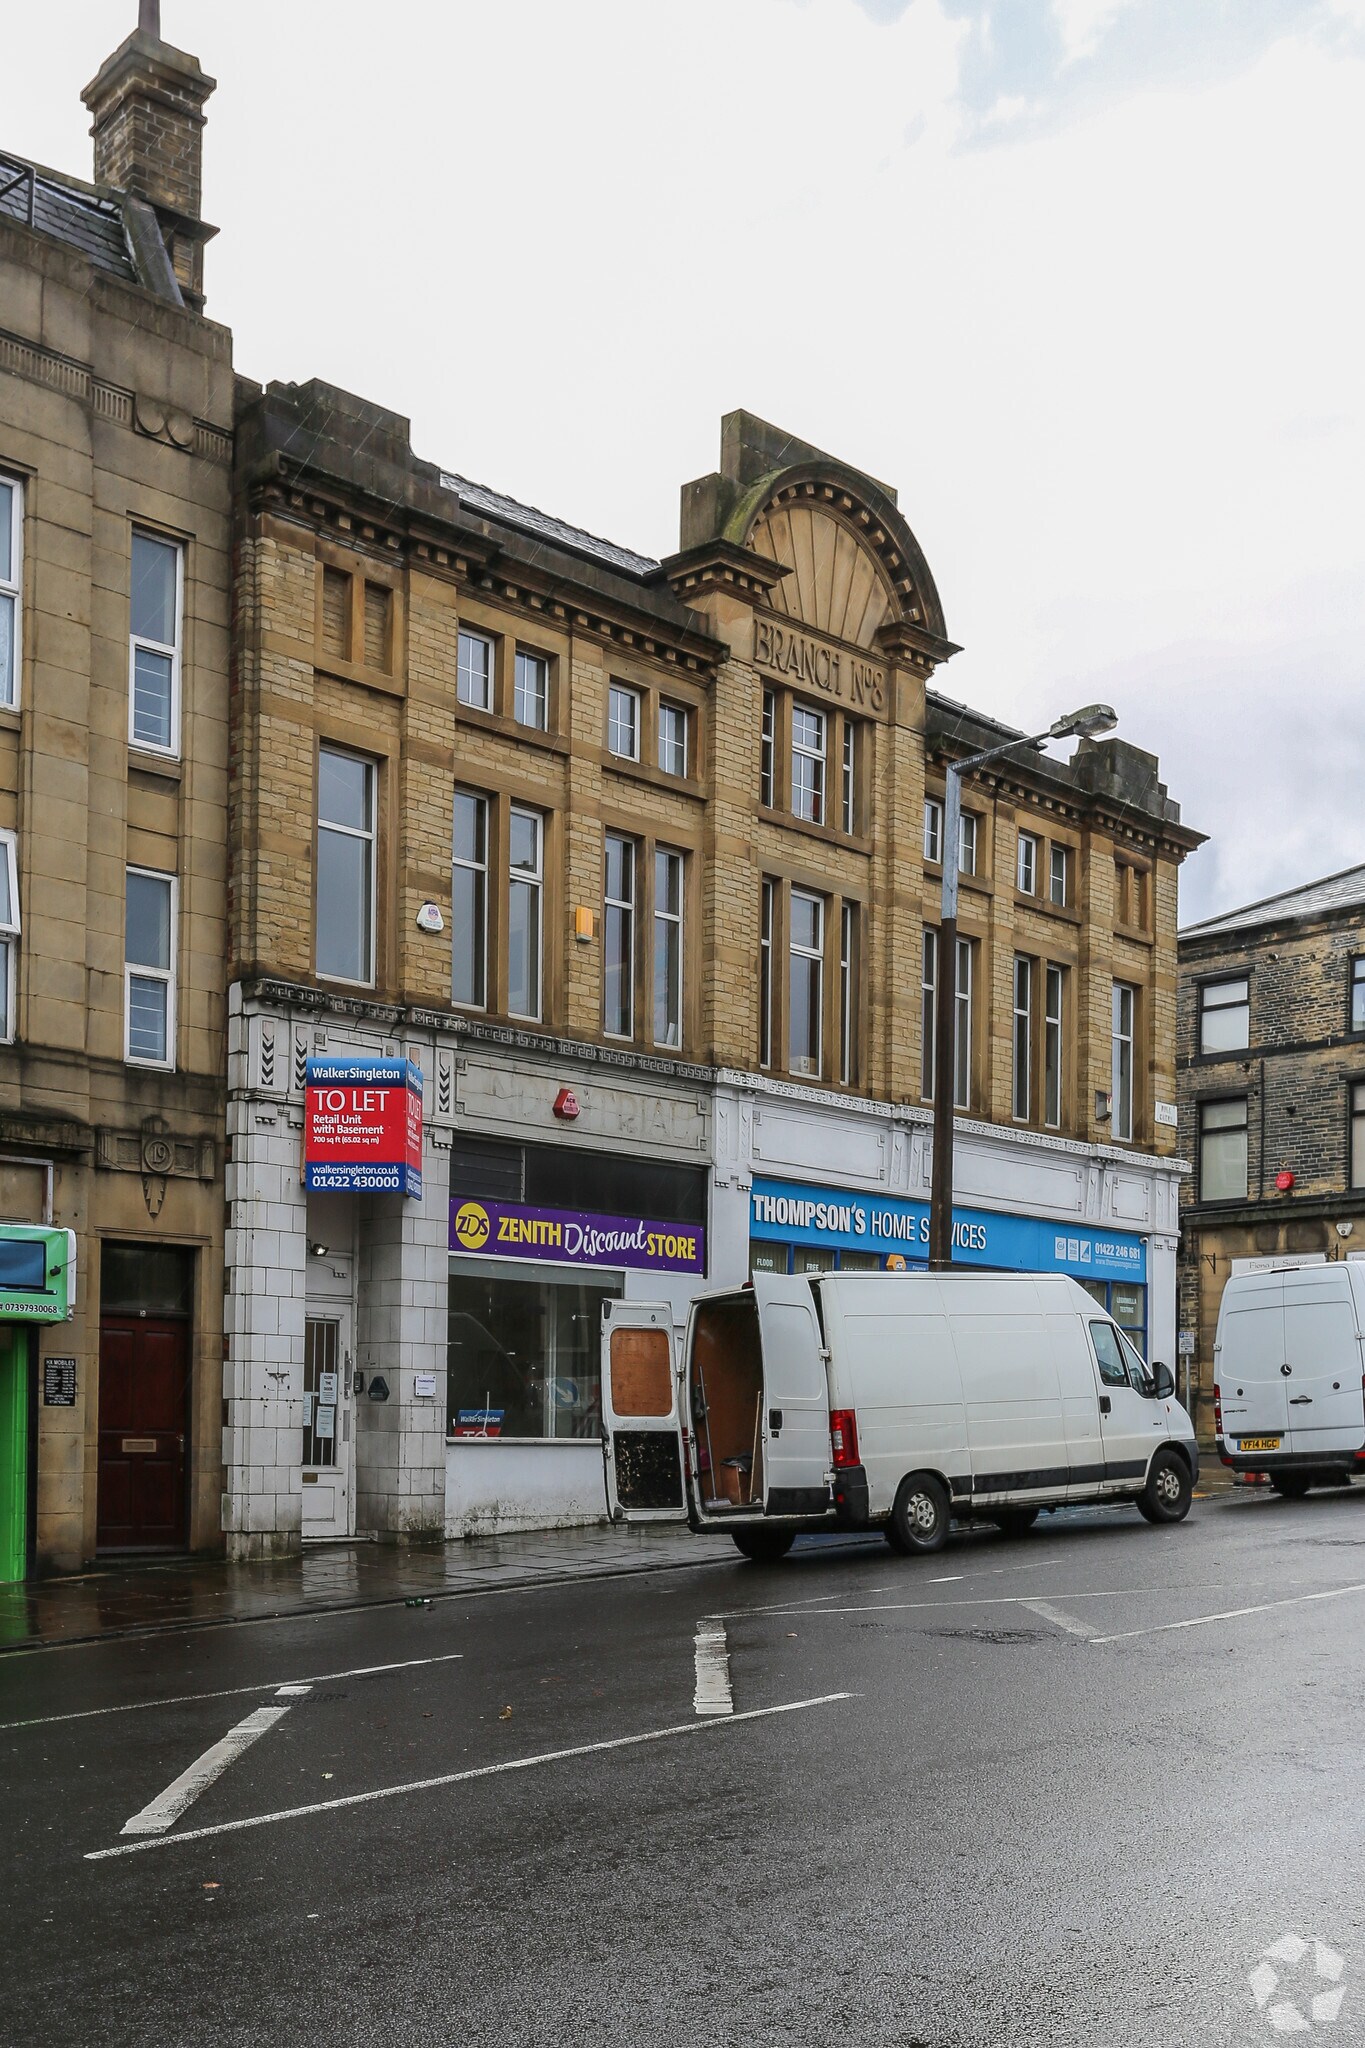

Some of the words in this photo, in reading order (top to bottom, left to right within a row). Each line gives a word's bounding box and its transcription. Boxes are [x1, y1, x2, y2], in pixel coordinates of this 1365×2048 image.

[754, 618, 842, 696] BRANCH
[313, 1090, 345, 1112] TO
[352, 1090, 390, 1112] LET
[313, 1114, 339, 1124] Retail
[341, 1115, 362, 1124] Unit
[313, 1124, 335, 1134] with
[337, 1125, 384, 1134] Basement
[326, 1137, 334, 1145] sq
[362, 1137, 370, 1145] sq
[370, 1136, 380, 1145] m)
[312, 1165, 399, 1176] walkersingleton.co.uk
[312, 1176, 350, 1187] 01422
[353, 1176, 400, 1188] 430000
[752, 1194, 867, 1235] THOMPSON'S
[871, 1210, 916, 1241] HOME
[457, 1213, 489, 1237] ZDS
[497, 1216, 562, 1247] ZENITH
[564, 1220, 647, 1257] Discount
[646, 1233, 697, 1260] STORE
[1094, 1242, 1115, 1256] 01422
[1115, 1245, 1128, 1258] 246
[1128, 1246, 1141, 1260] 681
[756, 1257, 774, 1267] FLOOD
[806, 1262, 820, 1272] FREE
[5, 1303, 58, 1313] 07397930068
[1242, 1440, 1260, 1449] YF14
[1261, 1440, 1277, 1448] HGC
